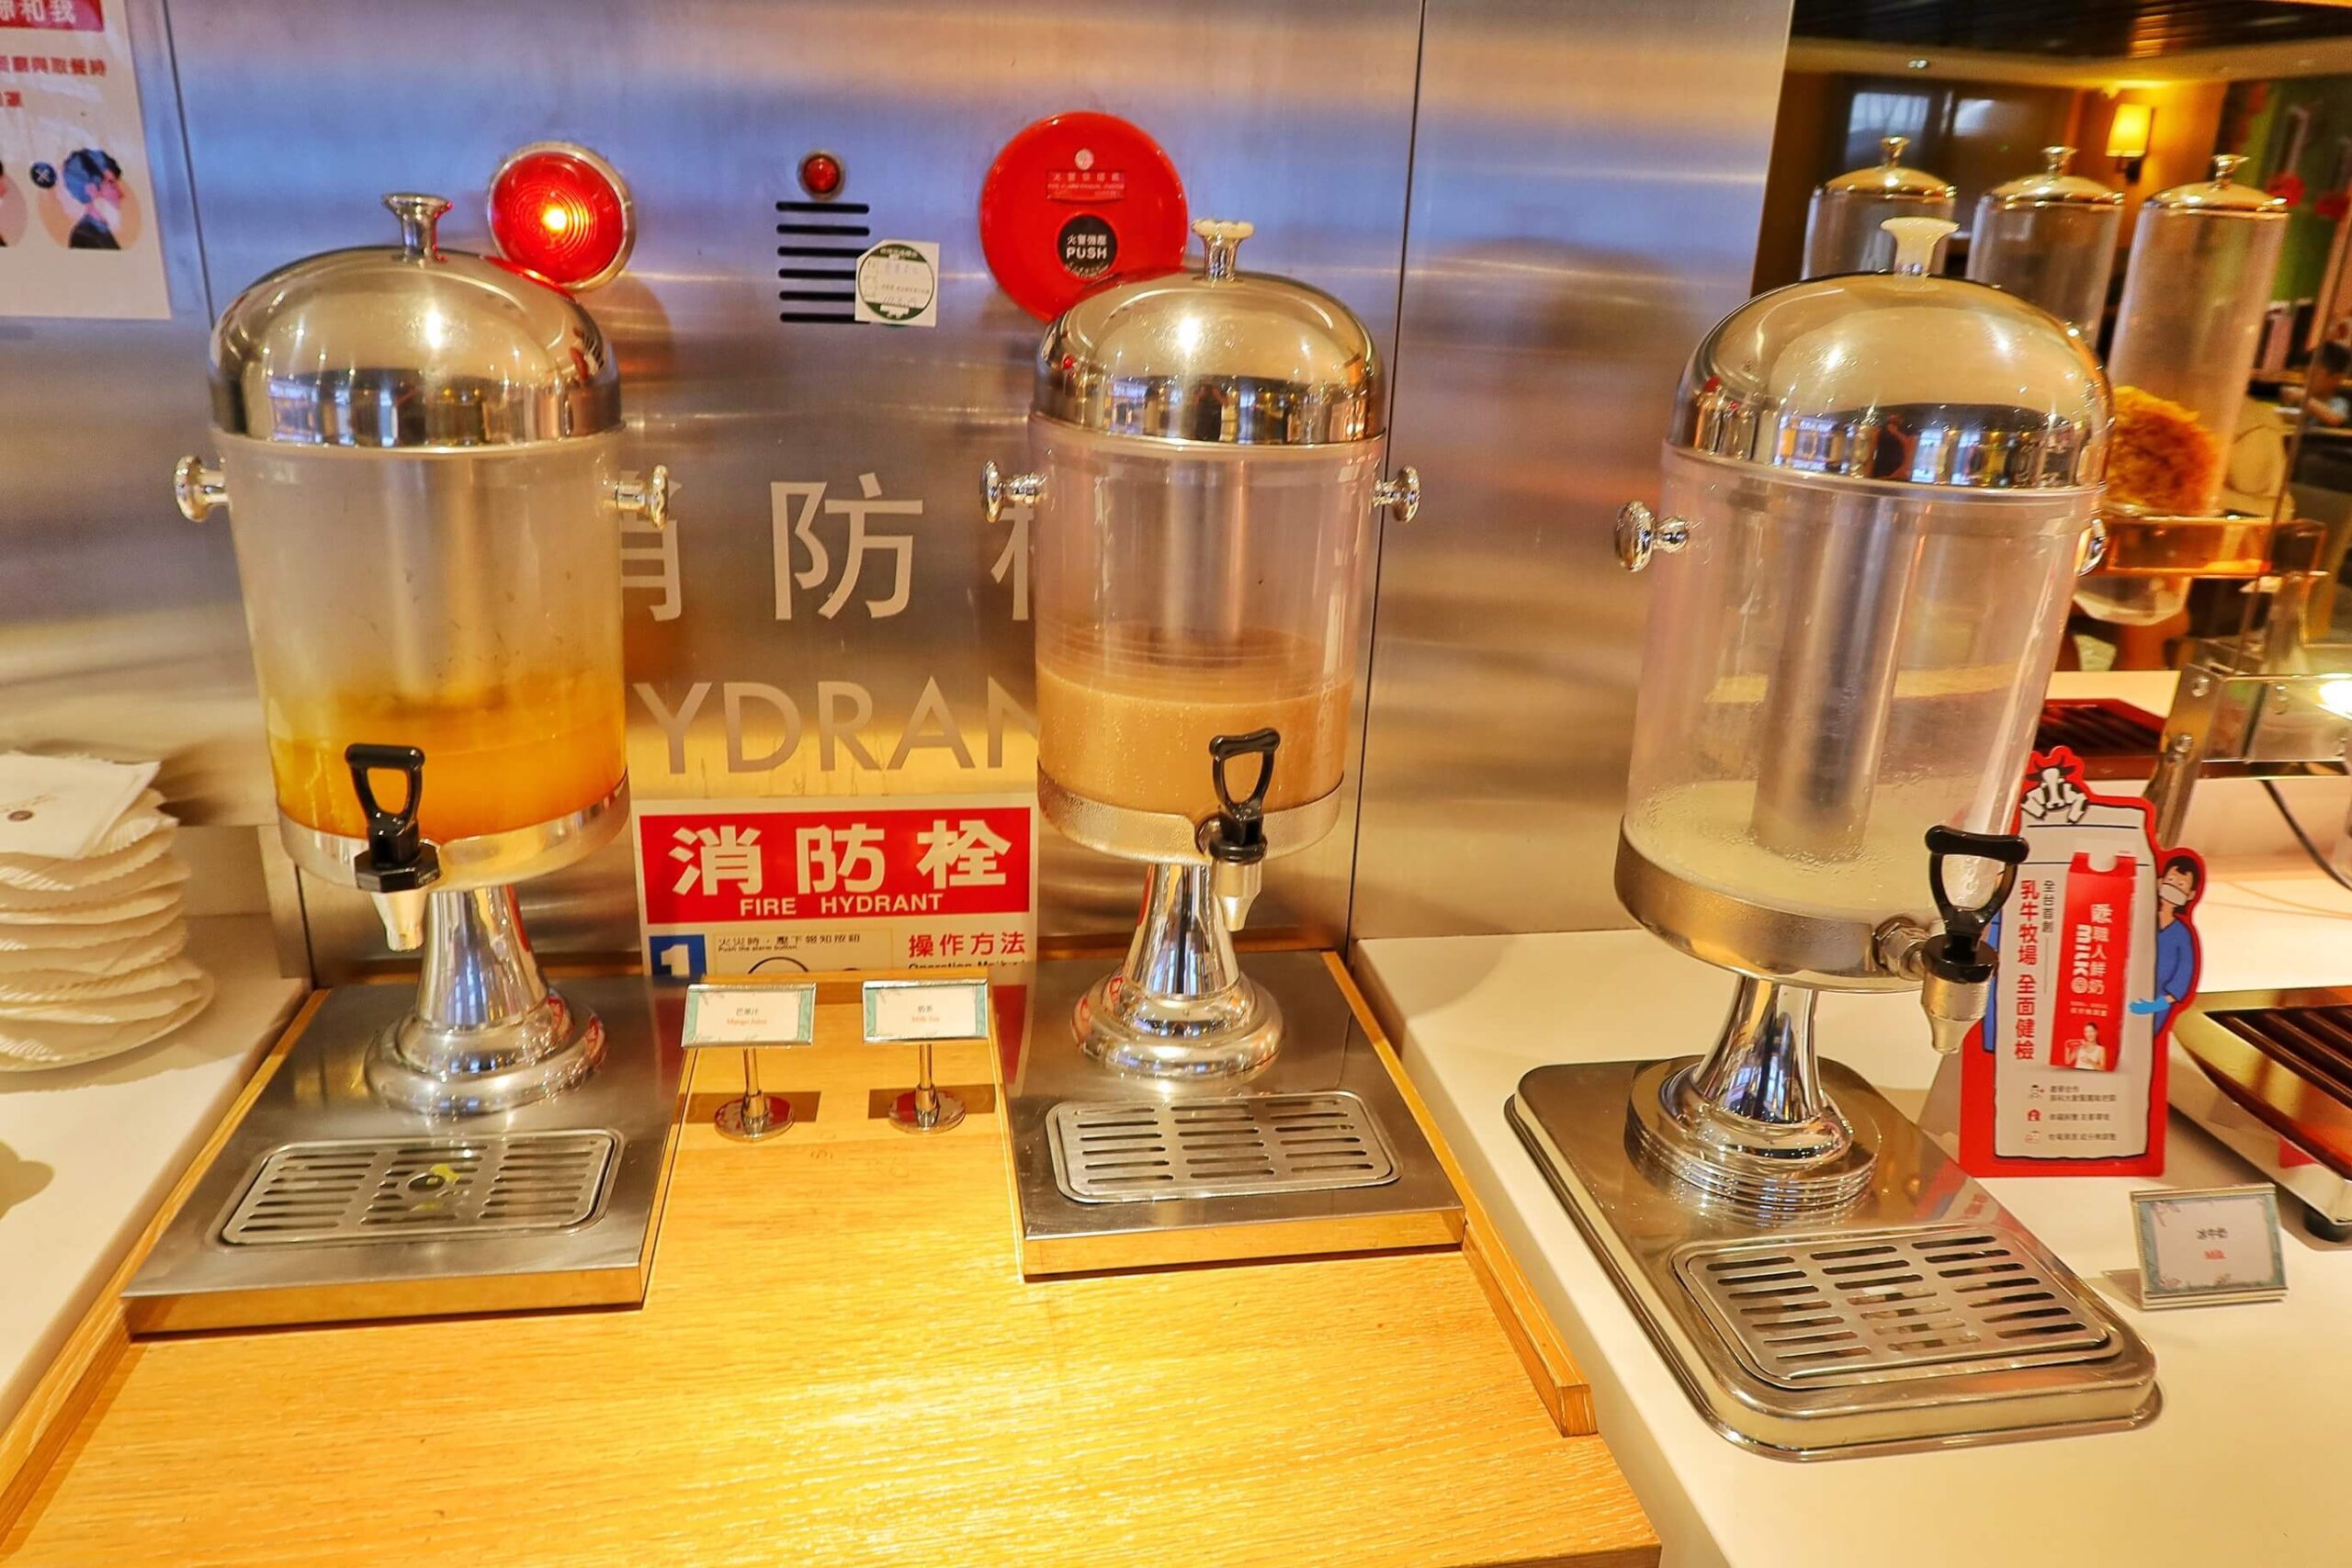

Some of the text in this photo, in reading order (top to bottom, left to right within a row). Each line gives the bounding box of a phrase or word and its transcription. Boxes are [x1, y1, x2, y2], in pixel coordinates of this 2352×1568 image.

[1066, 246, 1107, 260] PUSH
[668, 819, 1012, 897] 消防栓
[739, 892, 944, 917] FIRE HYDRANT
[661, 943, 690, 976] 1
[908, 931, 1025, 958] 操作方法
[2014, 880, 2040, 1060] 乳牛牧場 全面健檢
